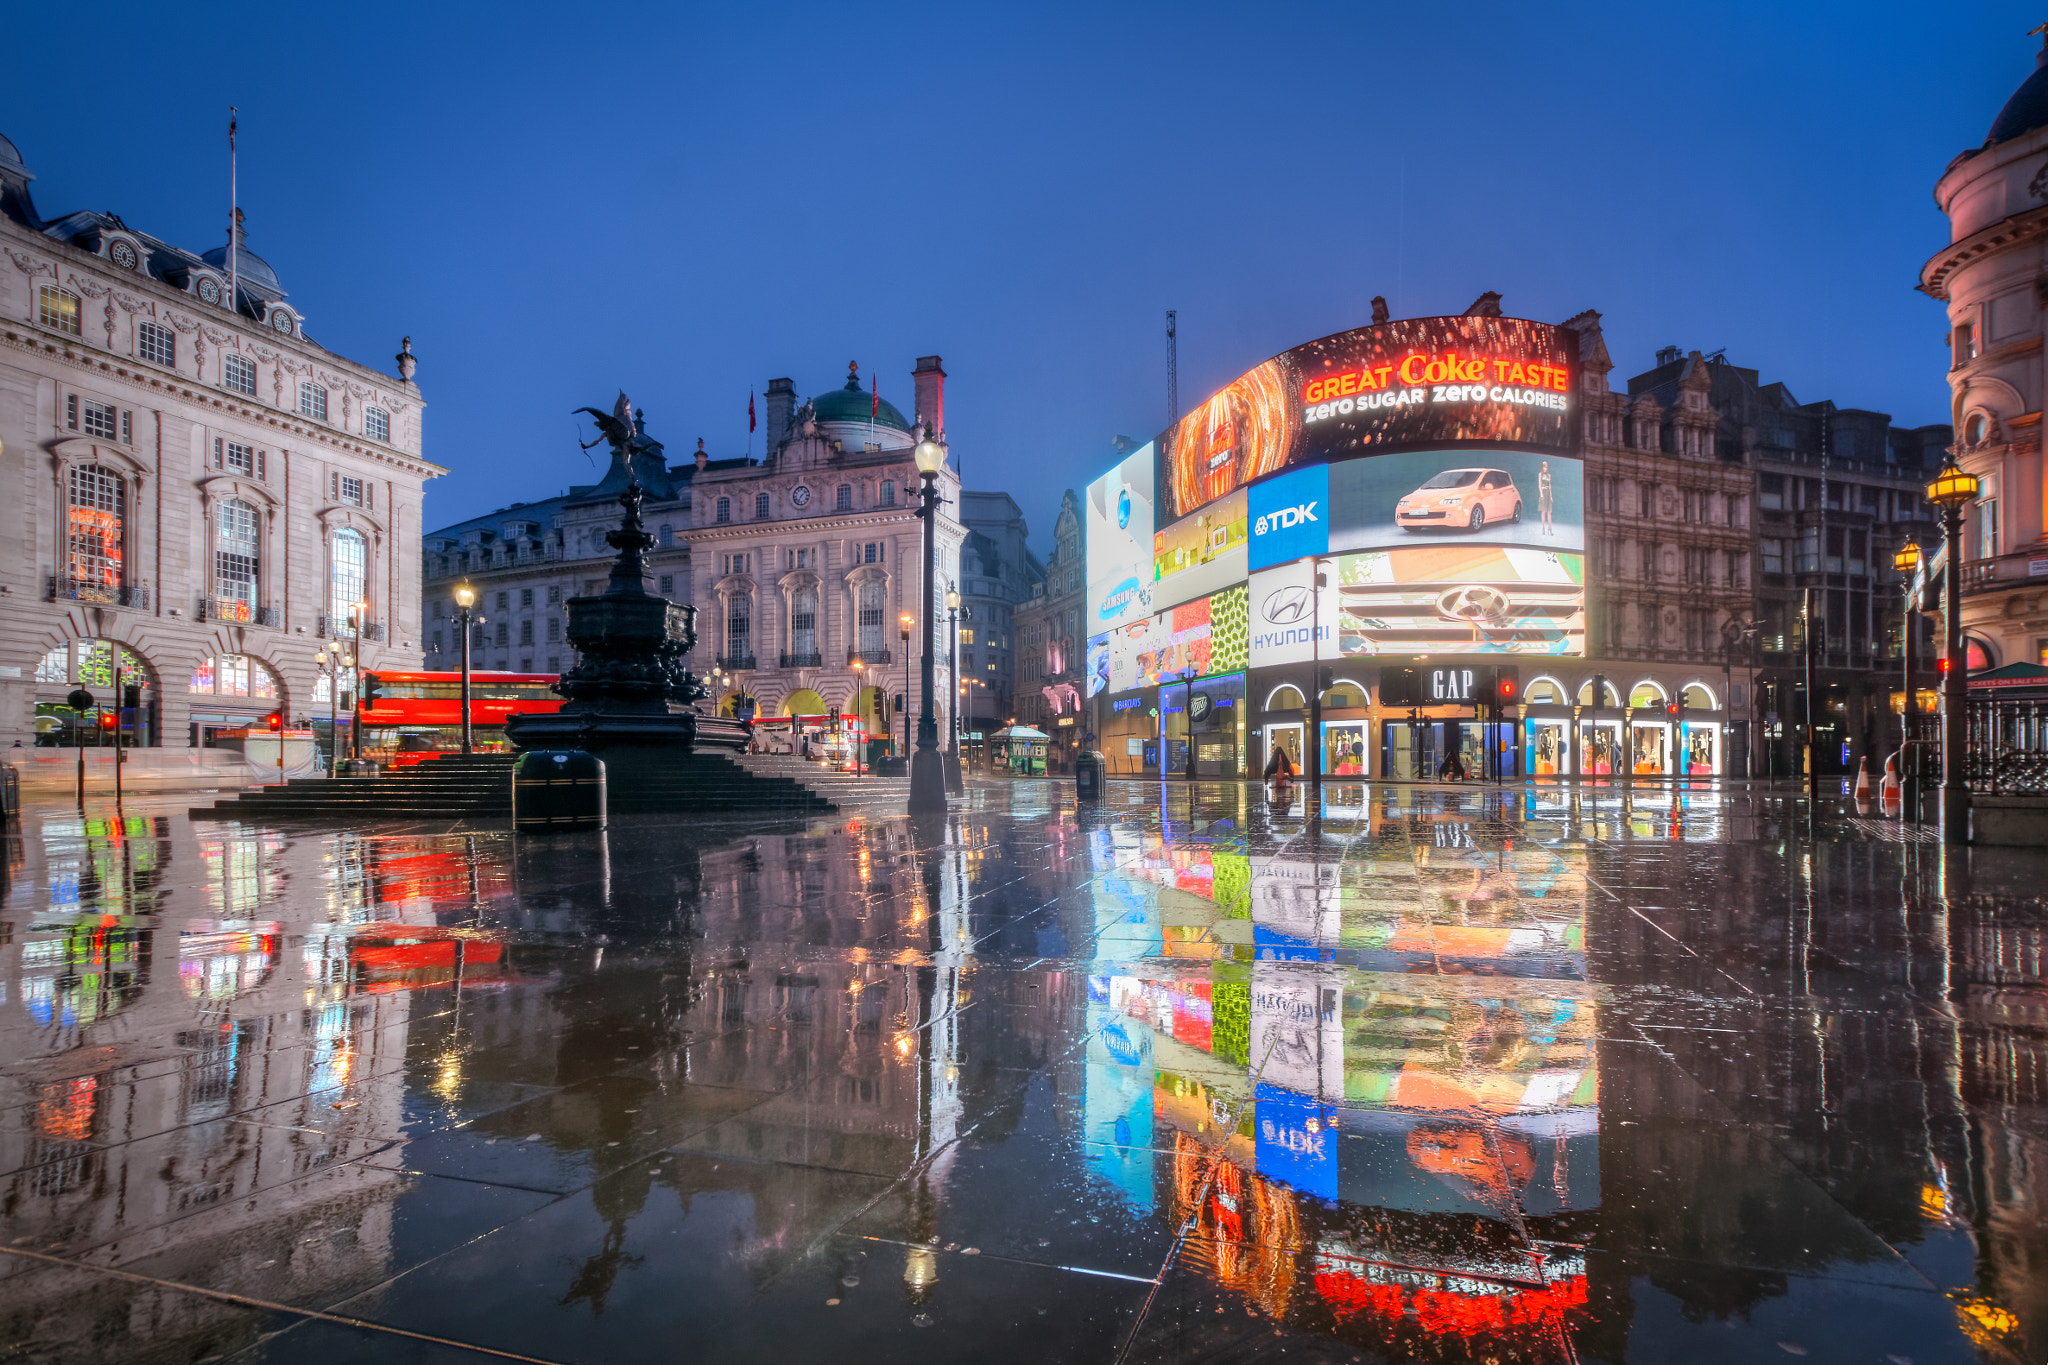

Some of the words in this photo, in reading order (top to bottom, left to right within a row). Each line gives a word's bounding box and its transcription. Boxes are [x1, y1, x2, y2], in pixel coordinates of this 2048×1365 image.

[1306, 366, 1393, 403] GREAT
[1400, 353, 1486, 385] Coke
[1493, 360, 1568, 391] TASTE
[1305, 399, 1354, 424] zero
[1356, 388, 1425, 411] SUGAR
[1432, 385, 1487, 403] zero
[1490, 387, 1568, 411] CALORIES
[1209, 449, 1229, 469] zero
[1266, 500, 1319, 532] TDK
[1103, 587, 1136, 611] SAMSUNG
[1254, 625, 1329, 650] HYUNDAI
[1432, 670, 1473, 699] GAP
[1118, 697, 1142, 711] BARCLAYS
[1190, 696, 1208, 718] Boots
